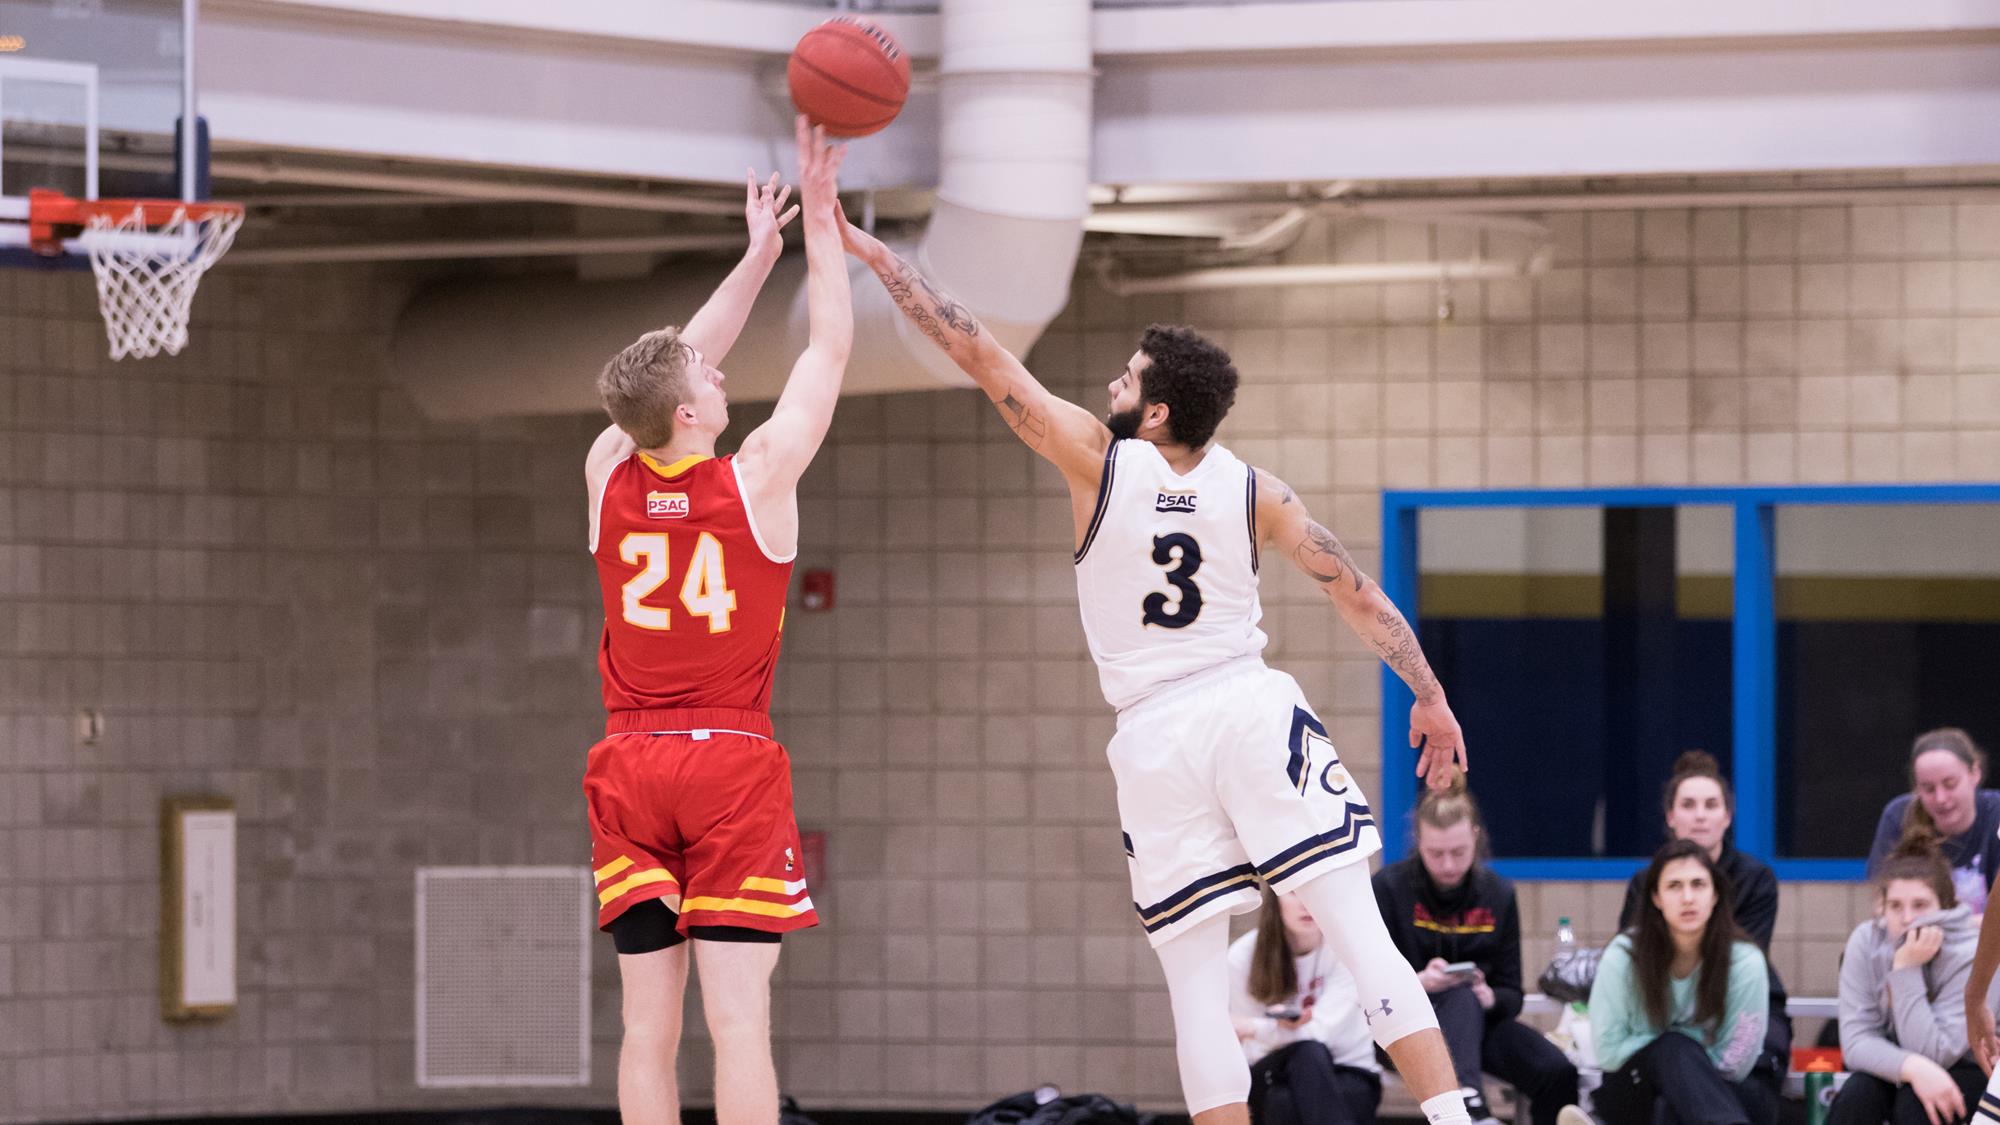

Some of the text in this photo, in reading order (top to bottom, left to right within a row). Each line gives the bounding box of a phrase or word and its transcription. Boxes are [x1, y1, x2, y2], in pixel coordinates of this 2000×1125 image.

[648, 500, 687, 511] PSAC
[1156, 493, 1197, 507] PSAC
[619, 532, 737, 634] 24
[1142, 531, 1204, 630] 3
